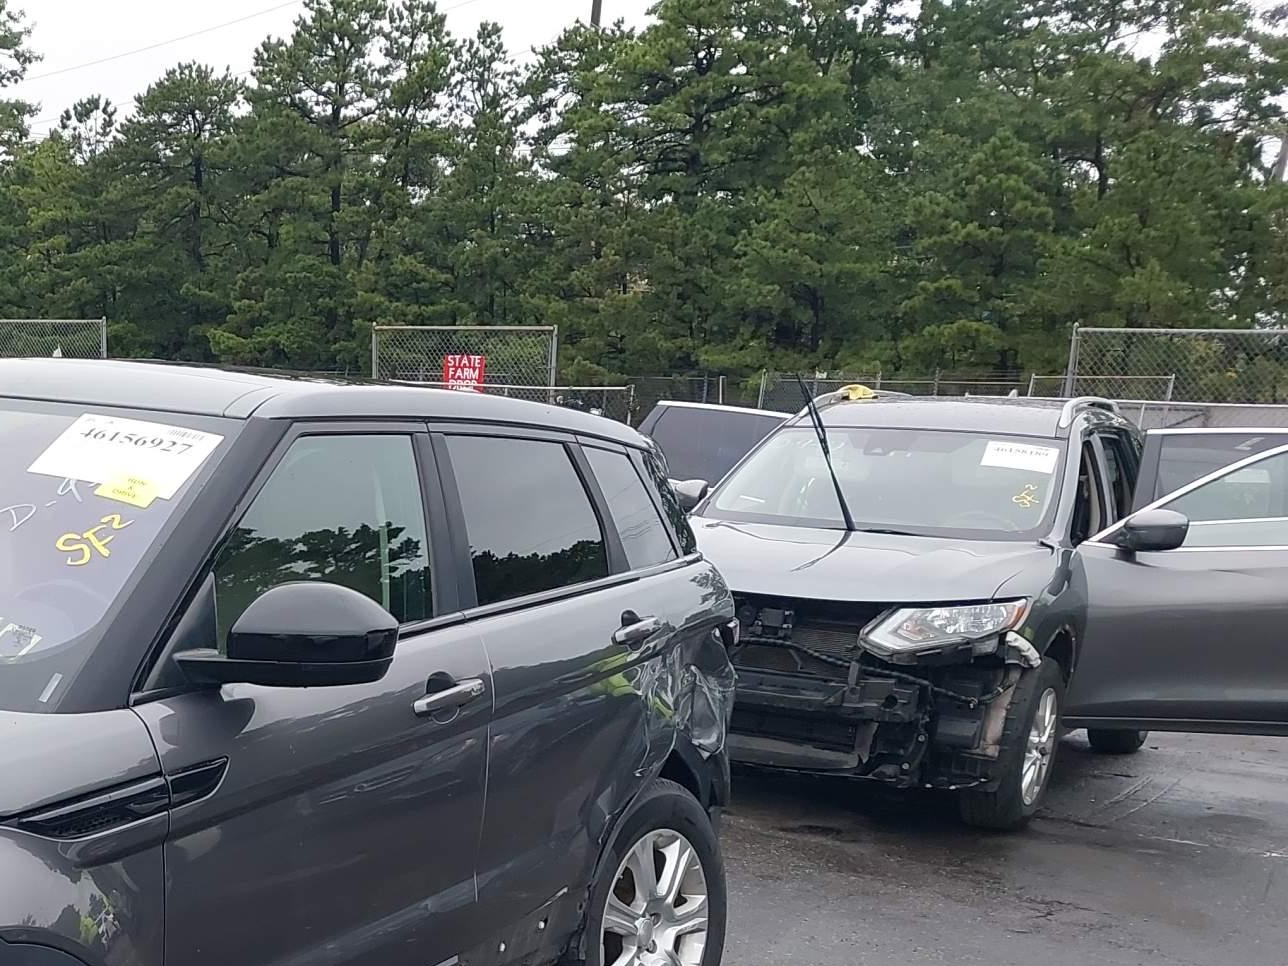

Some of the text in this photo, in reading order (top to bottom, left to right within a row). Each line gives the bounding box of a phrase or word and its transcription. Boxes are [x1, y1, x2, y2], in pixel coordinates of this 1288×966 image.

[447, 354, 482, 368] STATE
[448, 367, 479, 380] FARM
[80, 427, 193, 455] 46156927
